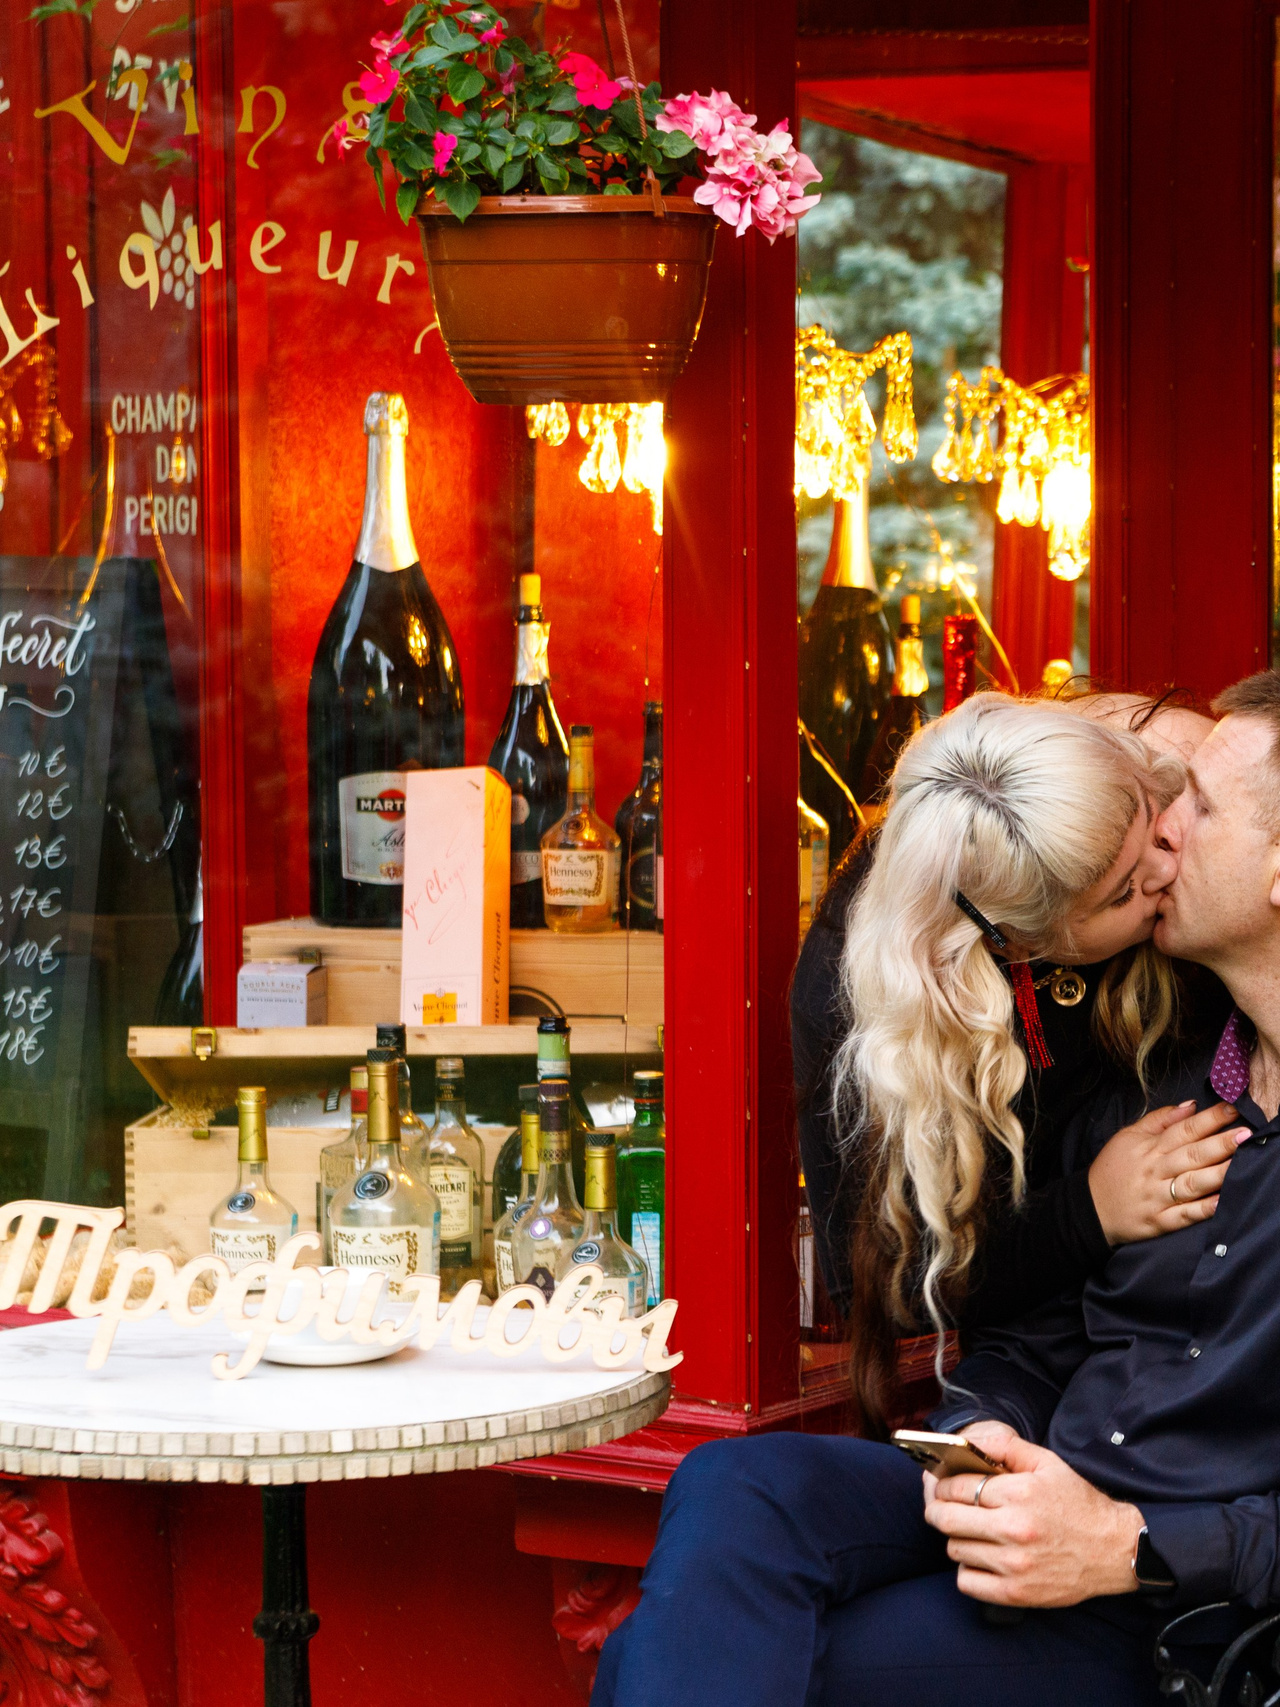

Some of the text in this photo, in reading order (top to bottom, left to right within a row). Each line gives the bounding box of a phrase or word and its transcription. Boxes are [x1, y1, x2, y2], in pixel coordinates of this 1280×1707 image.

[0, 219, 440, 367] Liqueur
[361, 800, 406, 811] MART
[549, 865, 595, 880] Hennessy
[216, 1246, 266, 1260] Hennessy
[340, 1249, 404, 1268] Hennessy
